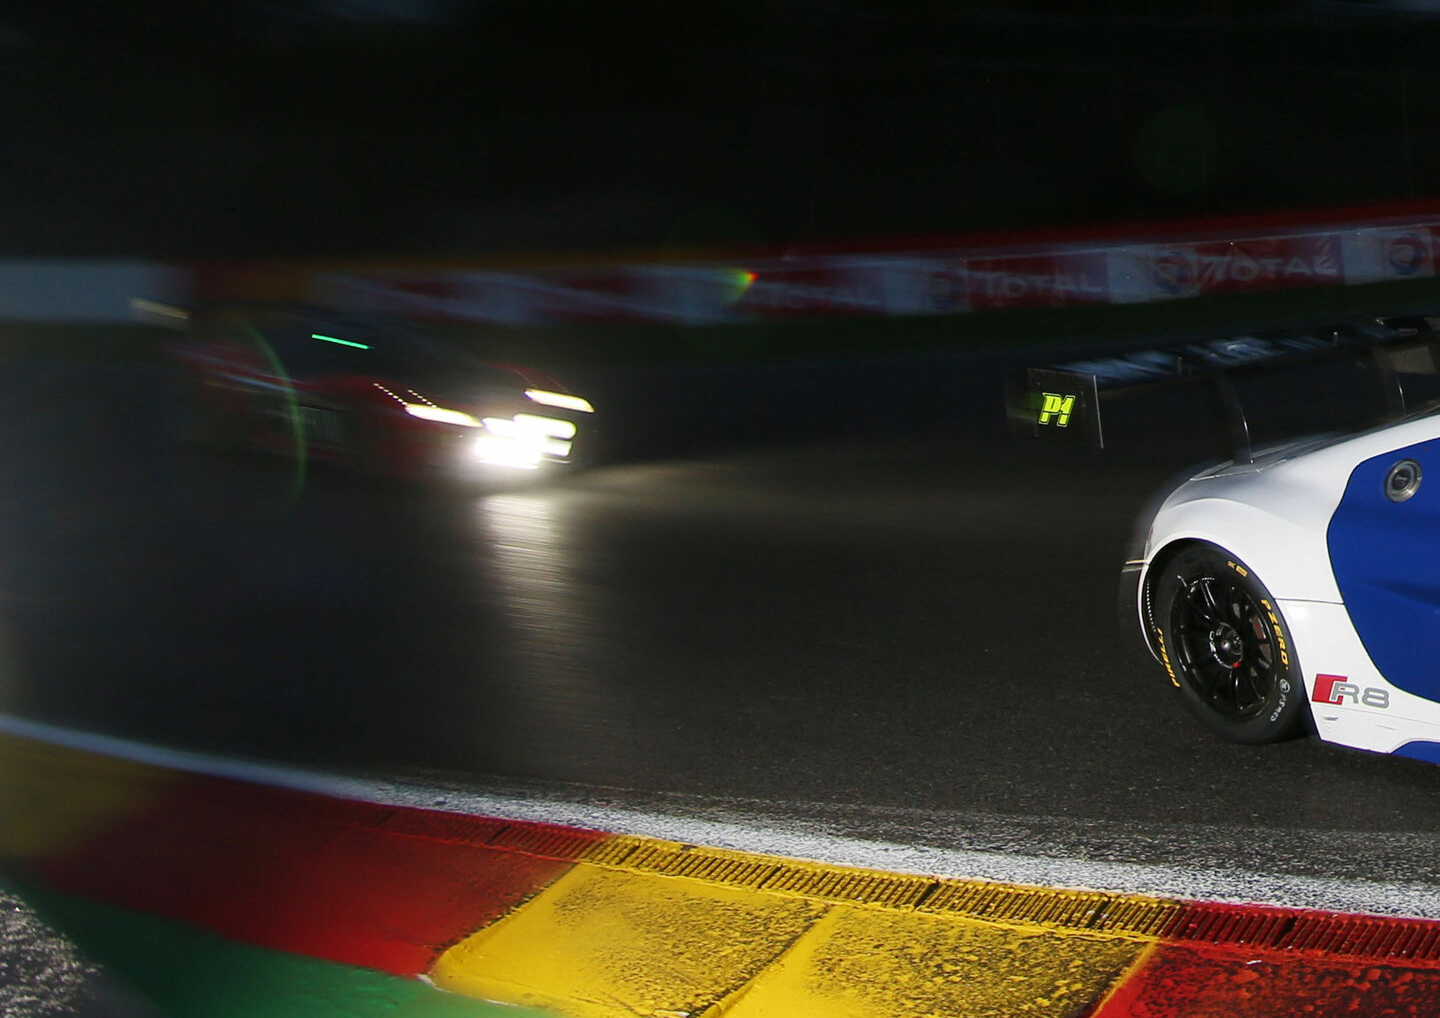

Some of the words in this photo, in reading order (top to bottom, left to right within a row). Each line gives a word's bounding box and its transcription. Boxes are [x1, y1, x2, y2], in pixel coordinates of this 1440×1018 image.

[1203, 254, 1337, 282] TOTAL
[979, 271, 1103, 299] TOTAL
[1038, 392, 1075, 428] P1
[1328, 681, 1390, 710] R8
